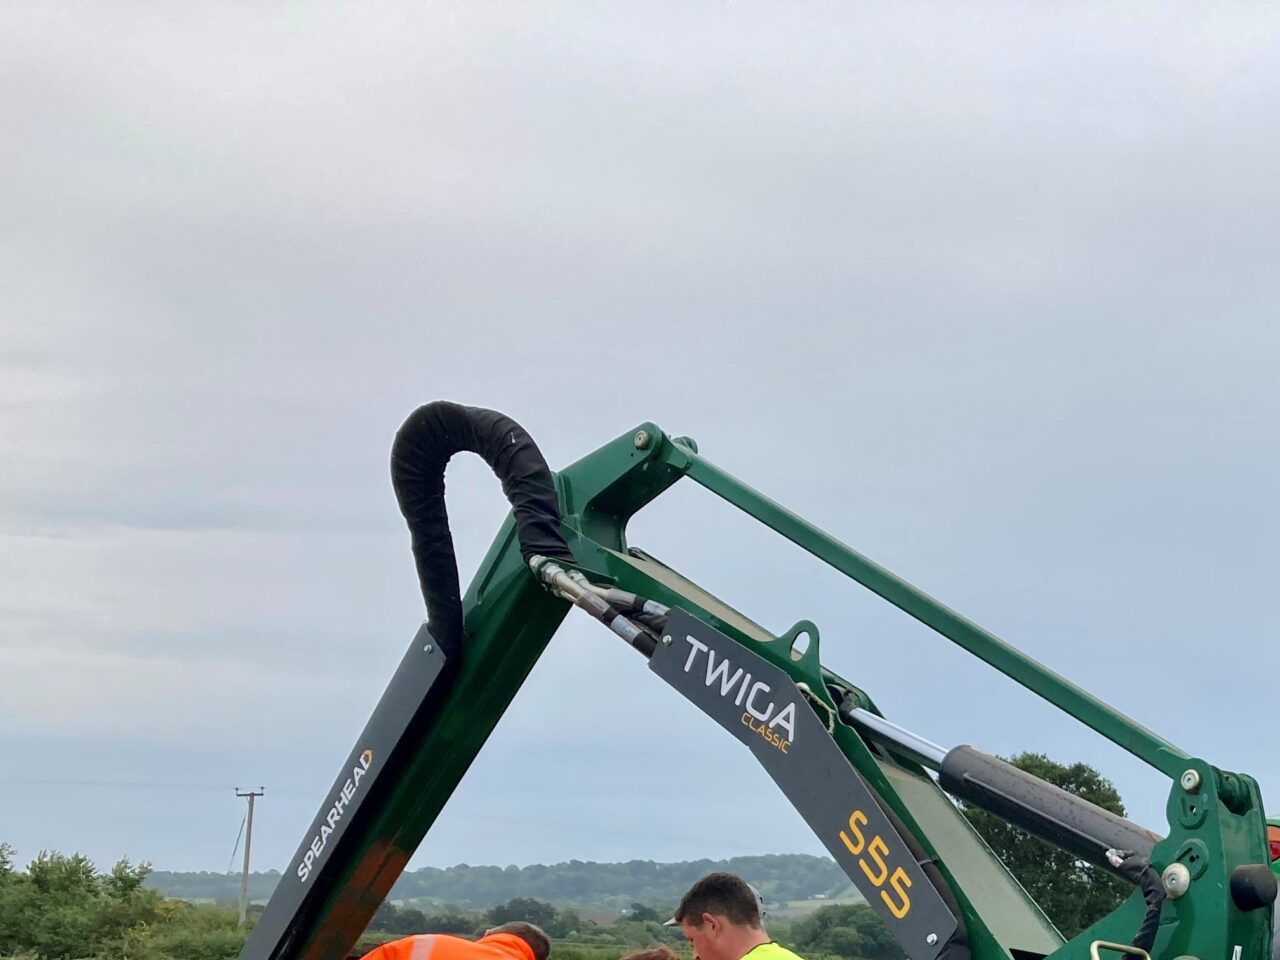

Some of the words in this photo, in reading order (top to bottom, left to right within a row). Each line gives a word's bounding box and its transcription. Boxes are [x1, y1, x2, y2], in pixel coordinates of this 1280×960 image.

[683, 634, 796, 742] TWIGA
[741, 711, 791, 754] CLASSIC
[297, 748, 373, 882] SPEARHEAD
